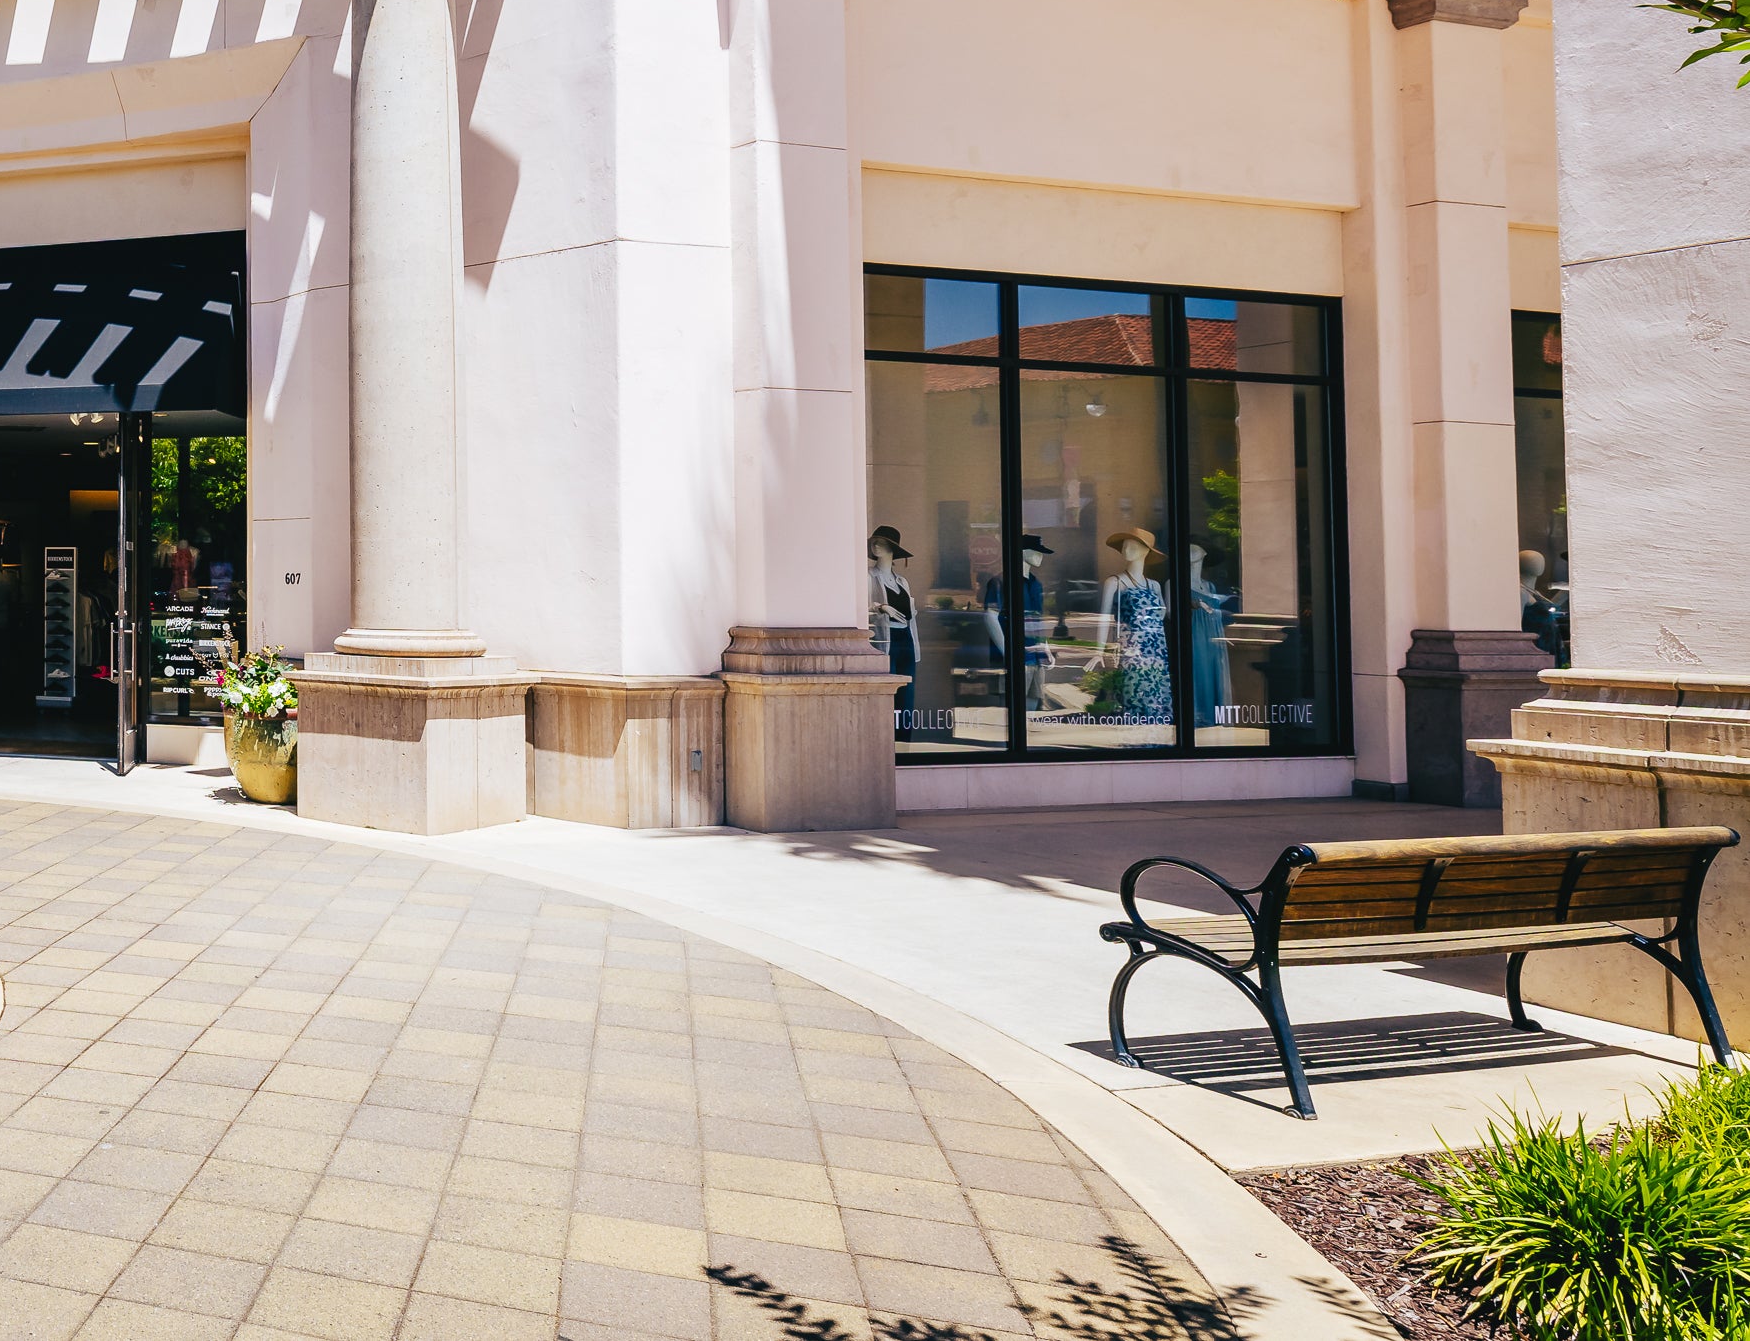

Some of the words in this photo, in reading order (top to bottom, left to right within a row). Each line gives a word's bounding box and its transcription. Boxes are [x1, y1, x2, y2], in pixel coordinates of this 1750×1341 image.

[285, 572, 301, 584] 607
[175, 668, 195, 676] CUTS
[1032, 716, 1064, 725] wear
[1066, 712, 1097, 725] with
[1099, 712, 1171, 725] confidence
